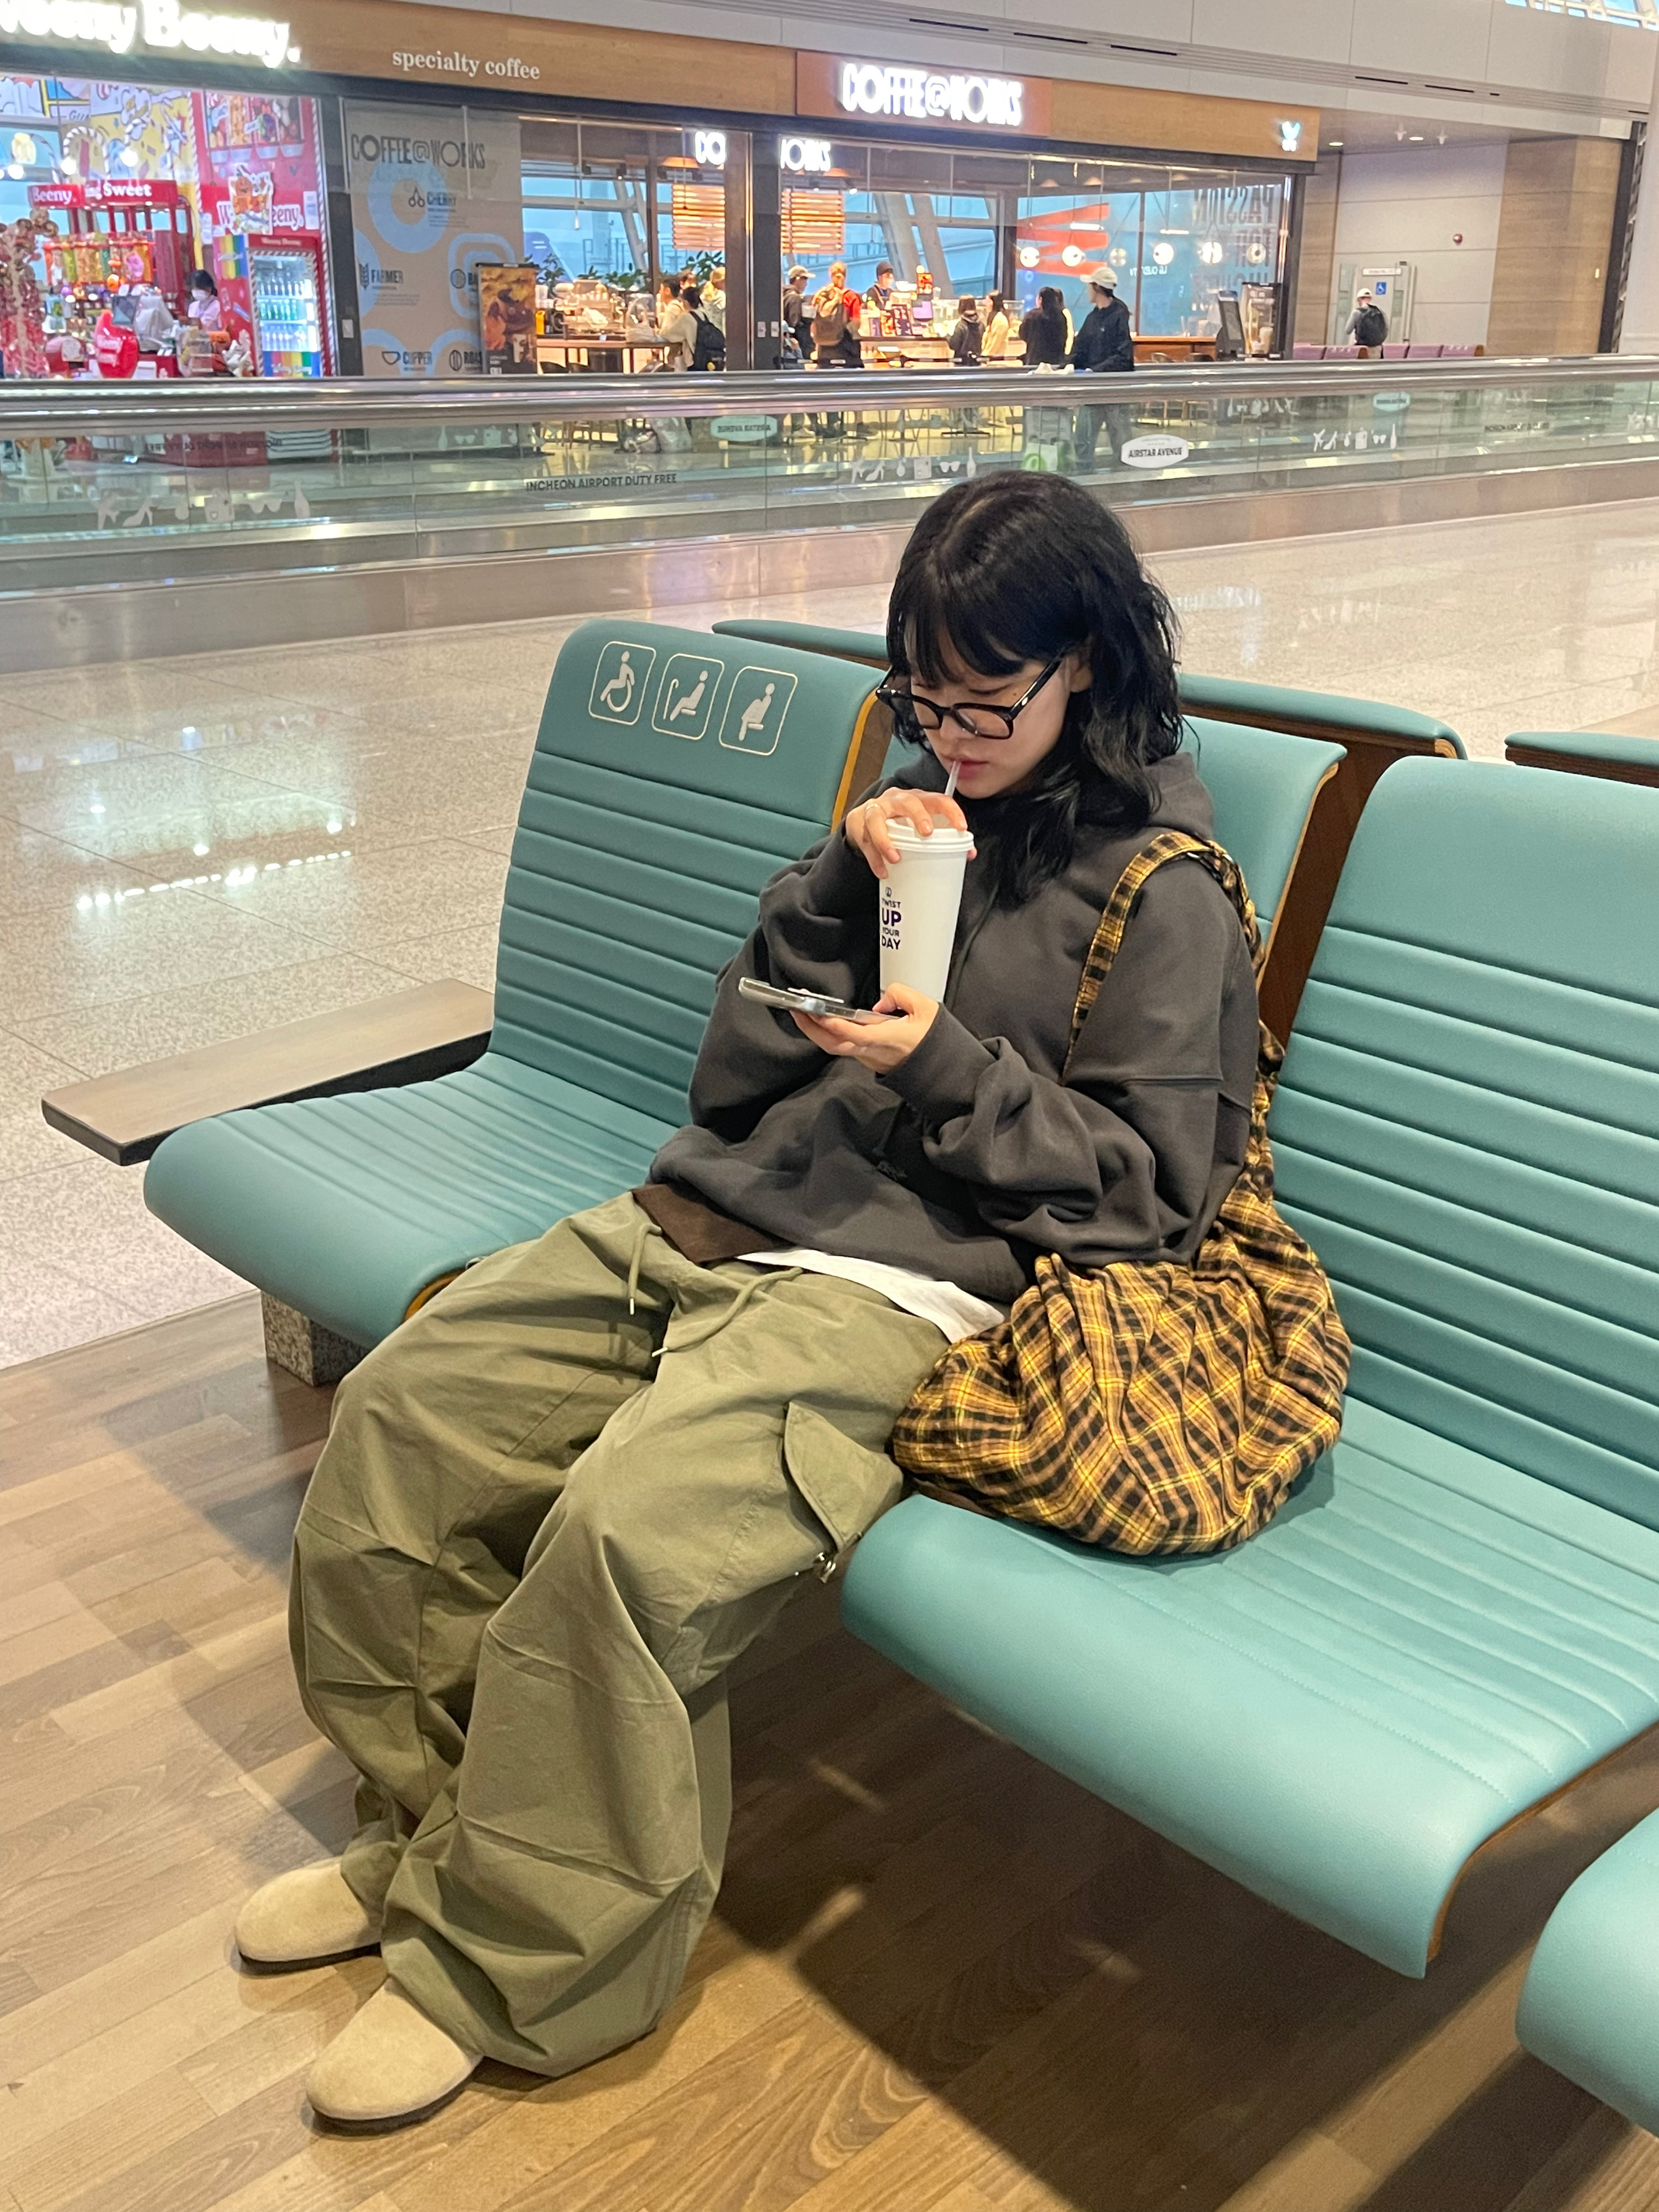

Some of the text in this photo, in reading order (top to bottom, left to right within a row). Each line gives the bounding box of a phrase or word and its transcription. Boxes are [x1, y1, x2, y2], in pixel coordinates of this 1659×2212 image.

[392, 50, 540, 80] specialty coffee
[103, 182, 152, 197] Sweet
[1128, 447, 1182, 458] AIRSTAR AVENUE
[526, 473, 677, 492] INCHEON AIRPORT DUTY FREE
[881, 898, 901, 909] TWIST
[881, 907, 901, 926] UP
[882, 927, 900, 937] YOUR
[881, 935, 901, 950] DAY
